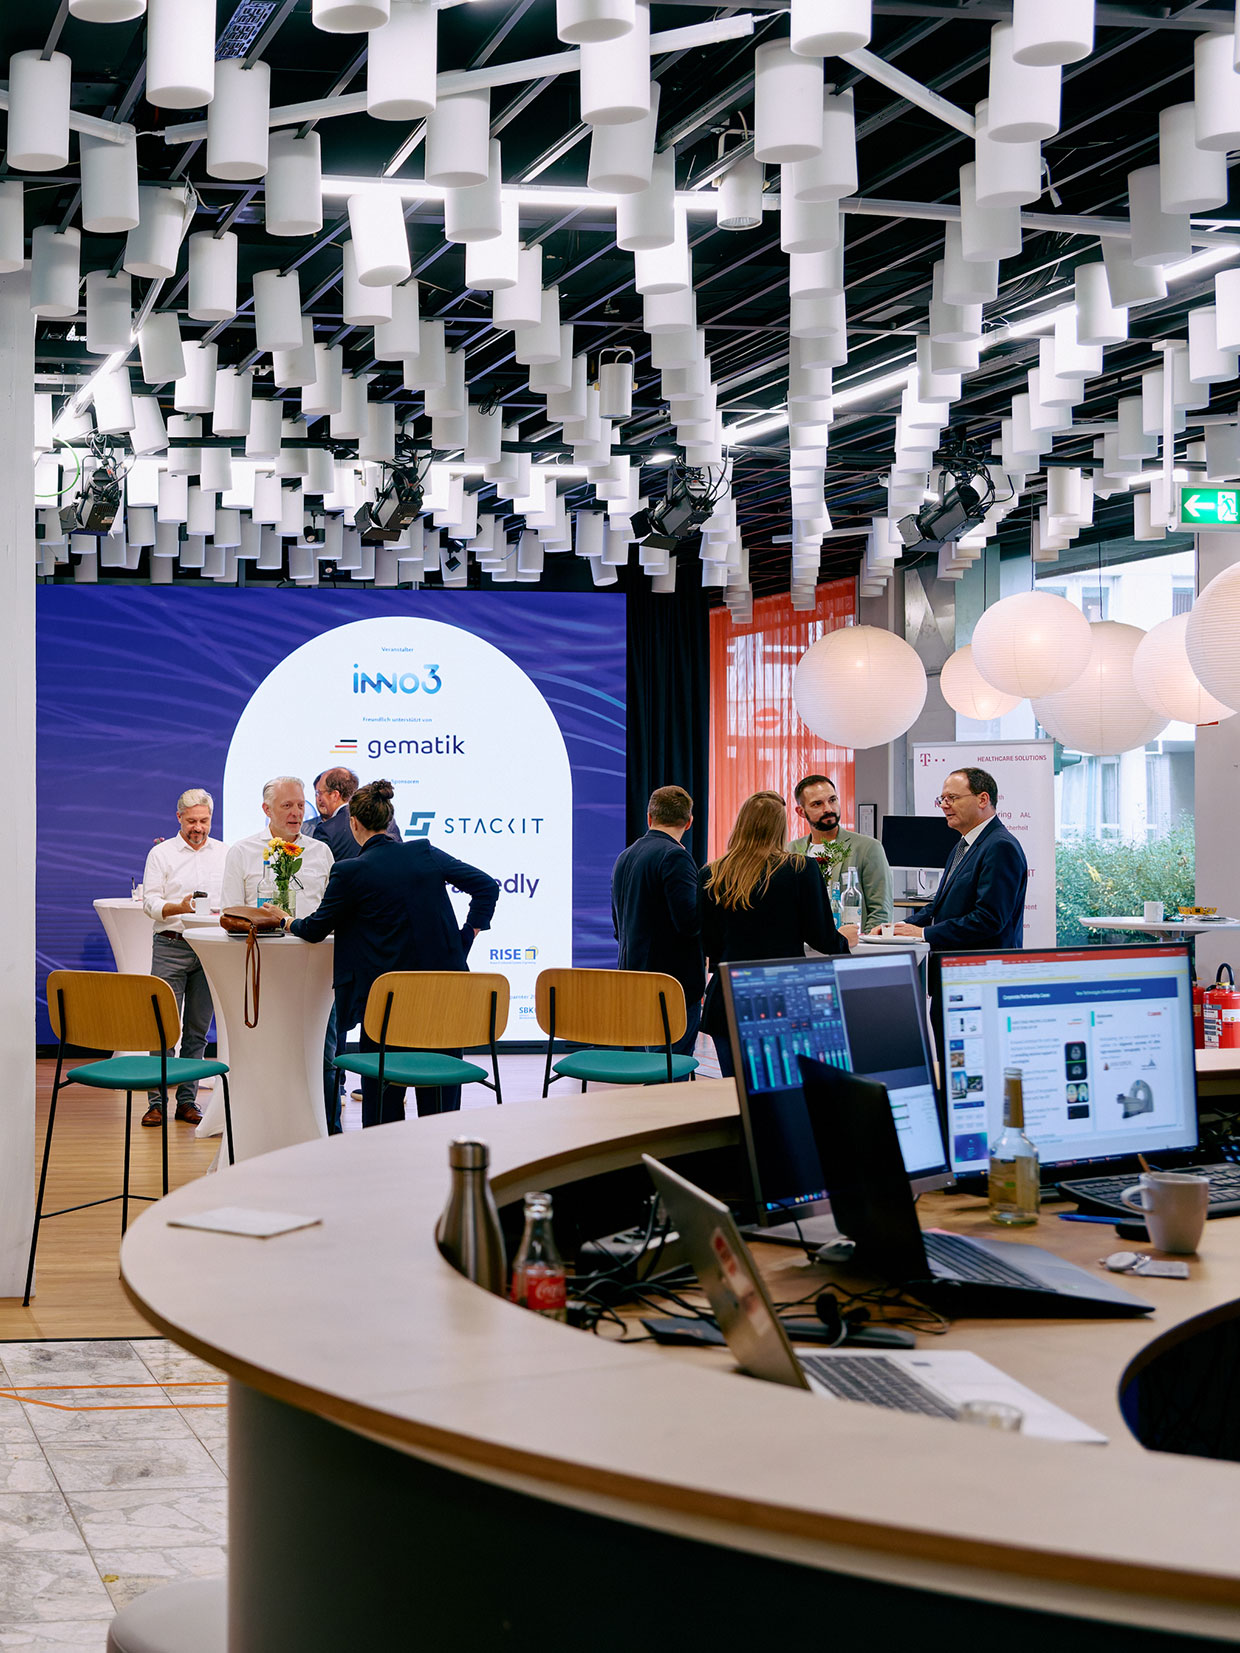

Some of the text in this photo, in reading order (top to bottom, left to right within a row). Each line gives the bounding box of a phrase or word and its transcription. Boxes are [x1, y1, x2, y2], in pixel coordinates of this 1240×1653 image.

[367, 734, 466, 760] gematik
[444, 817, 545, 834] STACKIT
[489, 948, 522, 960] RISE
[519, 1006, 534, 1014] SBK
